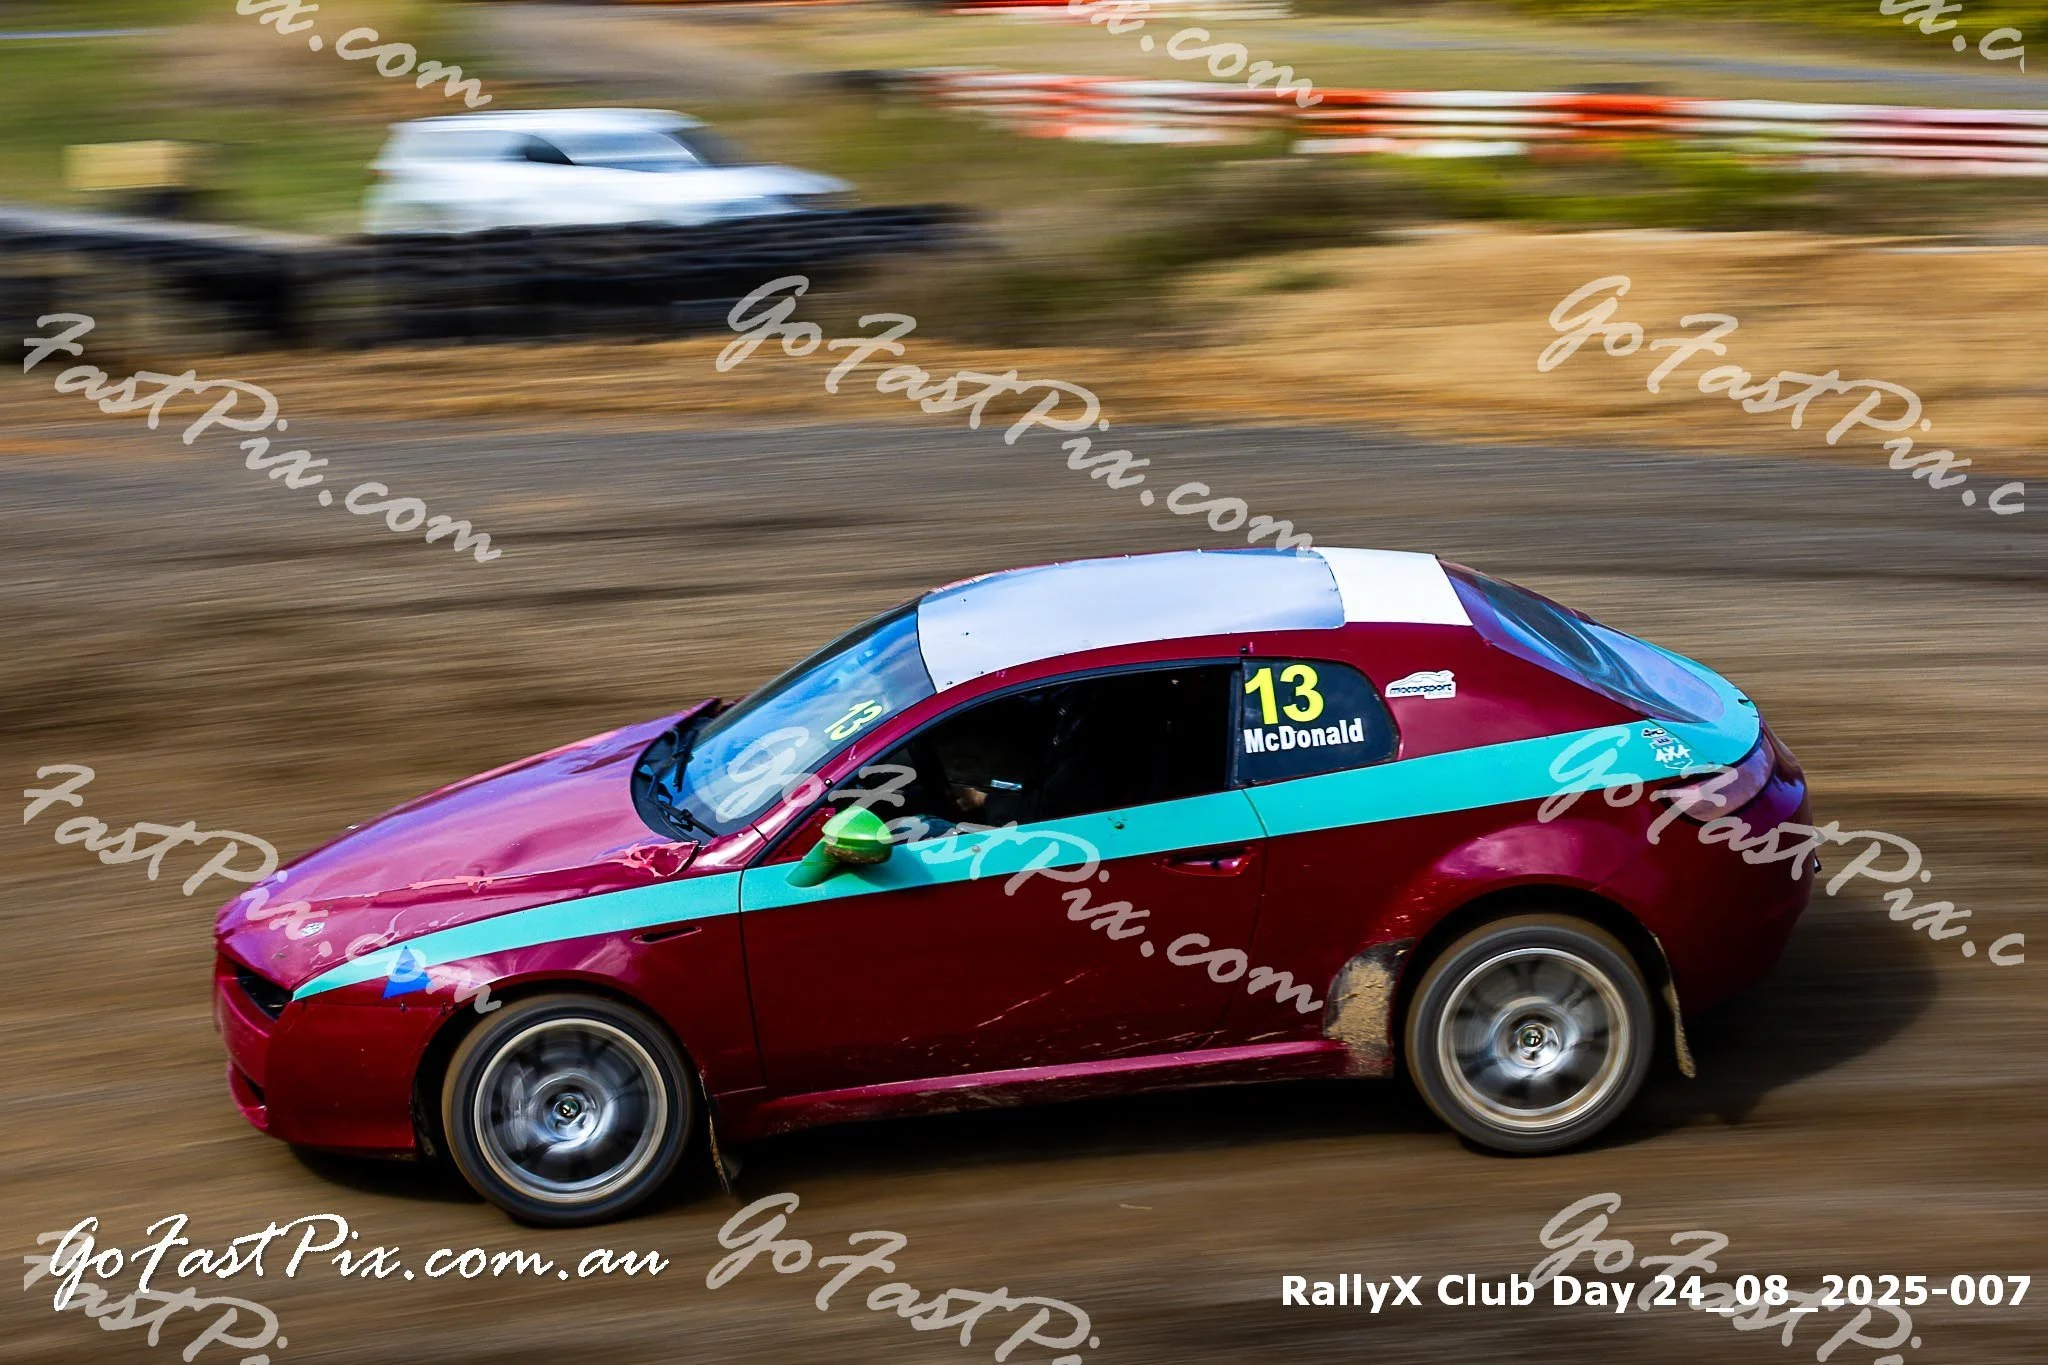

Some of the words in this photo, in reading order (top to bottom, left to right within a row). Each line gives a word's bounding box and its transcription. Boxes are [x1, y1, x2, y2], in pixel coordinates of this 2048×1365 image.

[1245, 664, 1325, 725] 13
[824, 700, 883, 741] 13
[1243, 717, 1365, 753] McDonald
